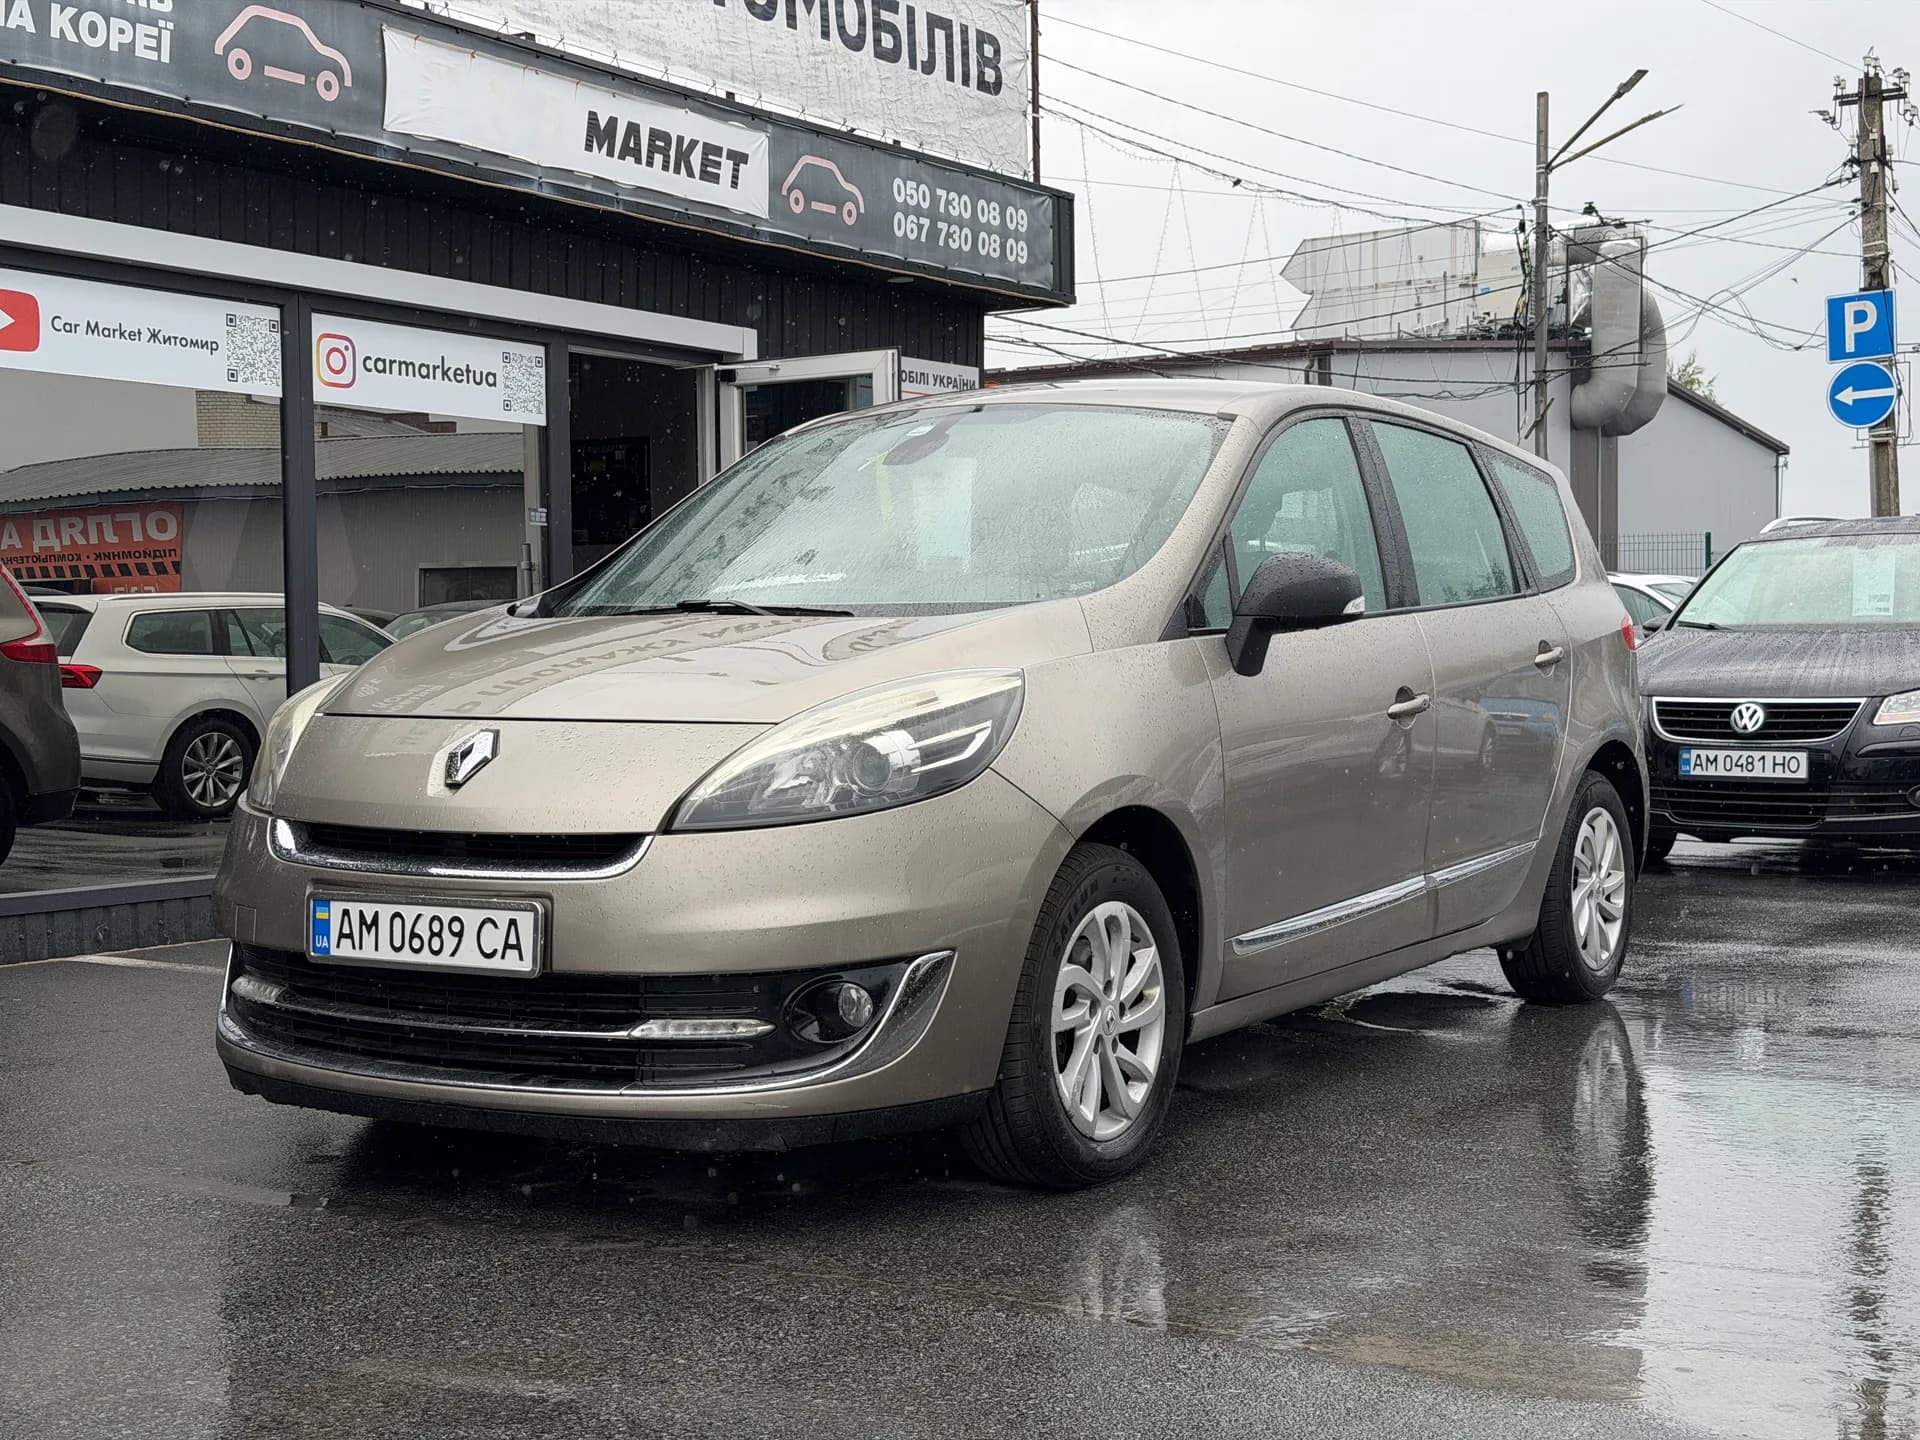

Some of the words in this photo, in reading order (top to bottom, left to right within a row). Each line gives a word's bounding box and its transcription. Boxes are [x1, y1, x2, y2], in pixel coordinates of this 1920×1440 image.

[50, 3, 175, 64] КОРЕЇ
[713, 0, 1003, 97] МОБІЛІВ
[584, 110, 749, 190] MARKET
[892, 177, 931, 209] 050
[936, 188, 972, 219] 730
[977, 199, 1001, 226] 08
[1006, 206, 1028, 233] 09
[893, 211, 931, 242] 067
[936, 221, 972, 252] 730
[978, 231, 1001, 258] 08
[1006, 238, 1028, 264] 09
[51, 315, 81, 333] Car
[85, 319, 143, 342] Market
[146, 327, 220, 355] Житомир
[1844, 300, 1878, 353] P
[362, 355, 497, 388] carmarketua
[932, 373, 976, 391] УКРАЇНИ
[1692, 753, 1718, 772] AM
[1723, 754, 1766, 773] 0481
[1772, 755, 1800, 774] HO
[315, 935, 329, 949] UA
[336, 908, 379, 952] AM
[389, 911, 465, 957] 0689
[476, 916, 524, 962] CA
